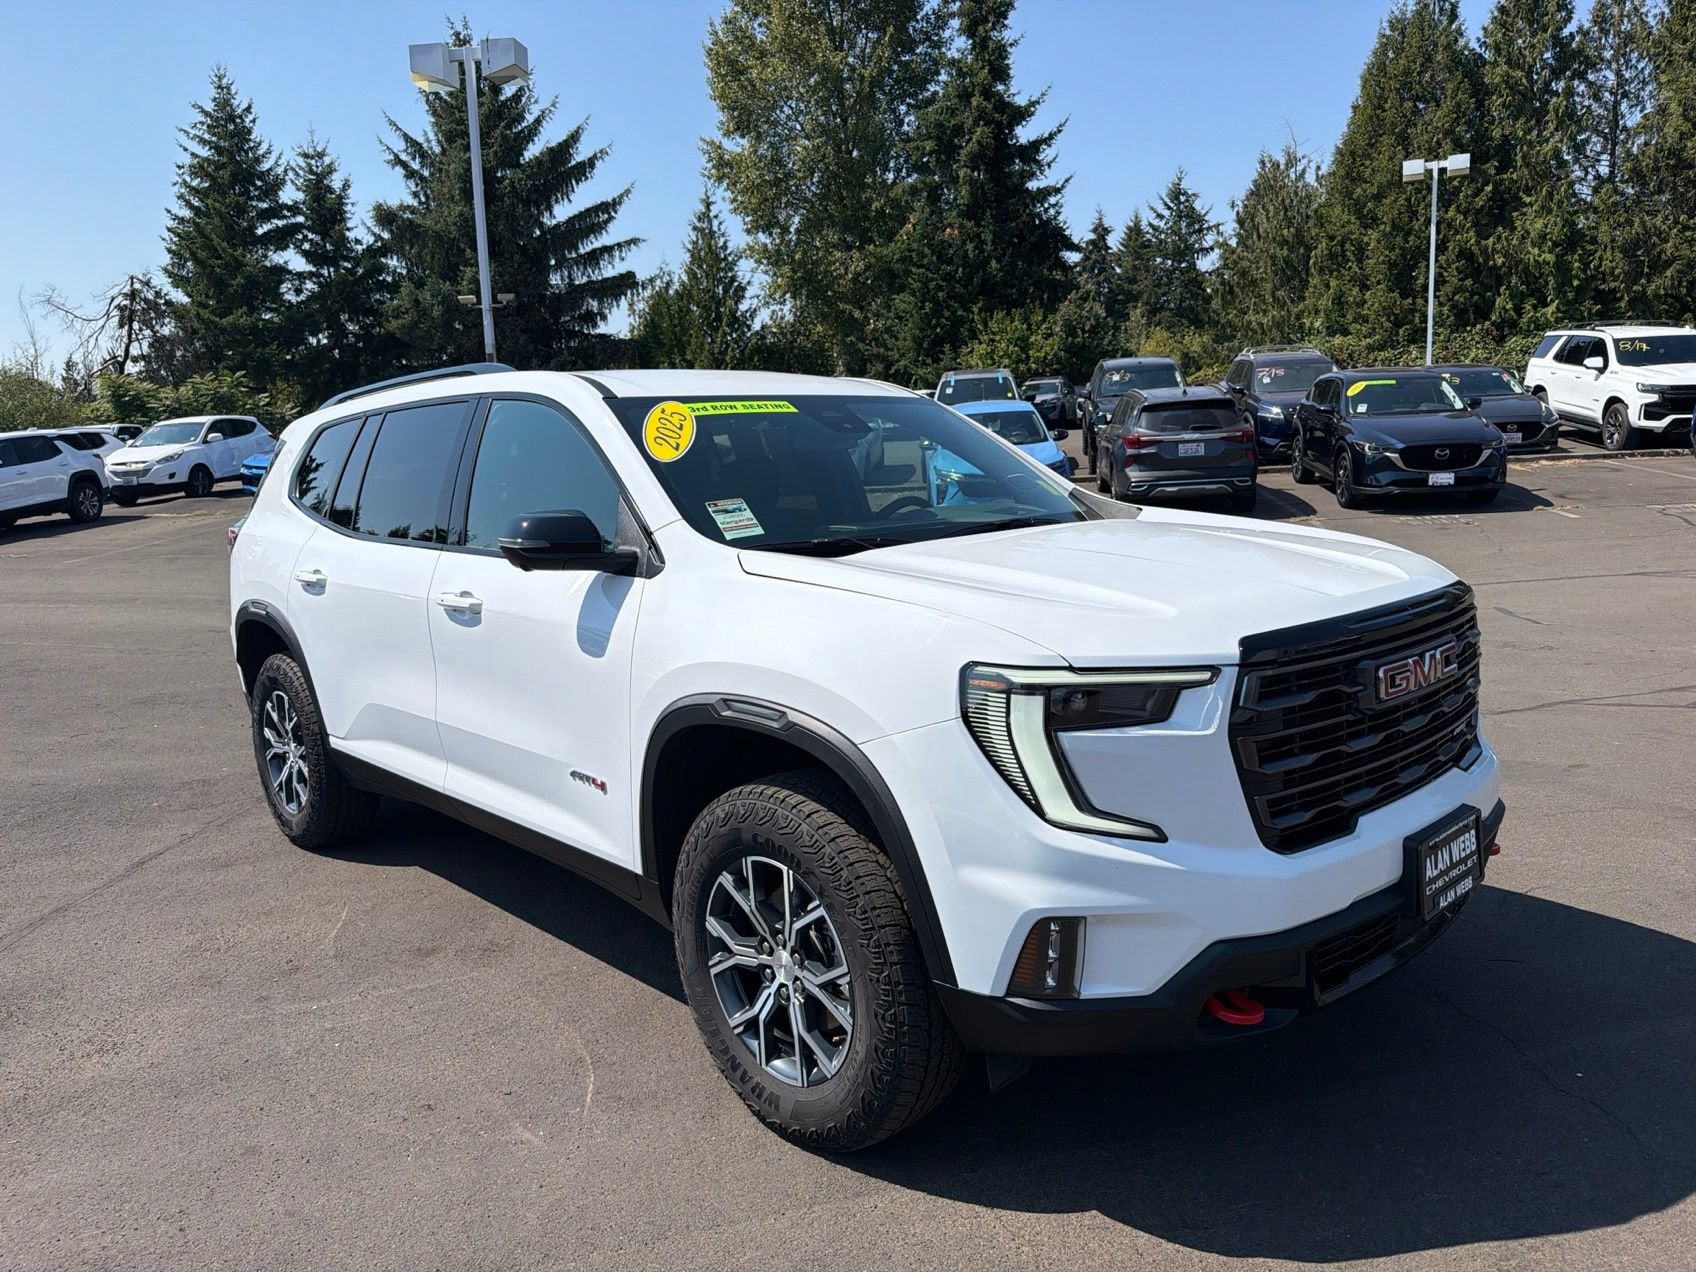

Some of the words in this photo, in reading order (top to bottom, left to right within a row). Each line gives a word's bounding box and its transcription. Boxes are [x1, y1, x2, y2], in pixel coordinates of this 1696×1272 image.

[687, 405, 709, 413] 3rd
[711, 404, 739, 412] ROW
[741, 403, 791, 411] SEATING
[653, 407, 687, 452] 2025
[1378, 642, 1458, 700] GMC
[569, 770, 609, 796] AT4
[1425, 844, 1450, 882] ALAN
[1450, 828, 1477, 863] WEBB
[1425, 854, 1478, 896] CHEVROLET
[1439, 887, 1455, 910] ALAN
[1455, 875, 1473, 898] WEBB
